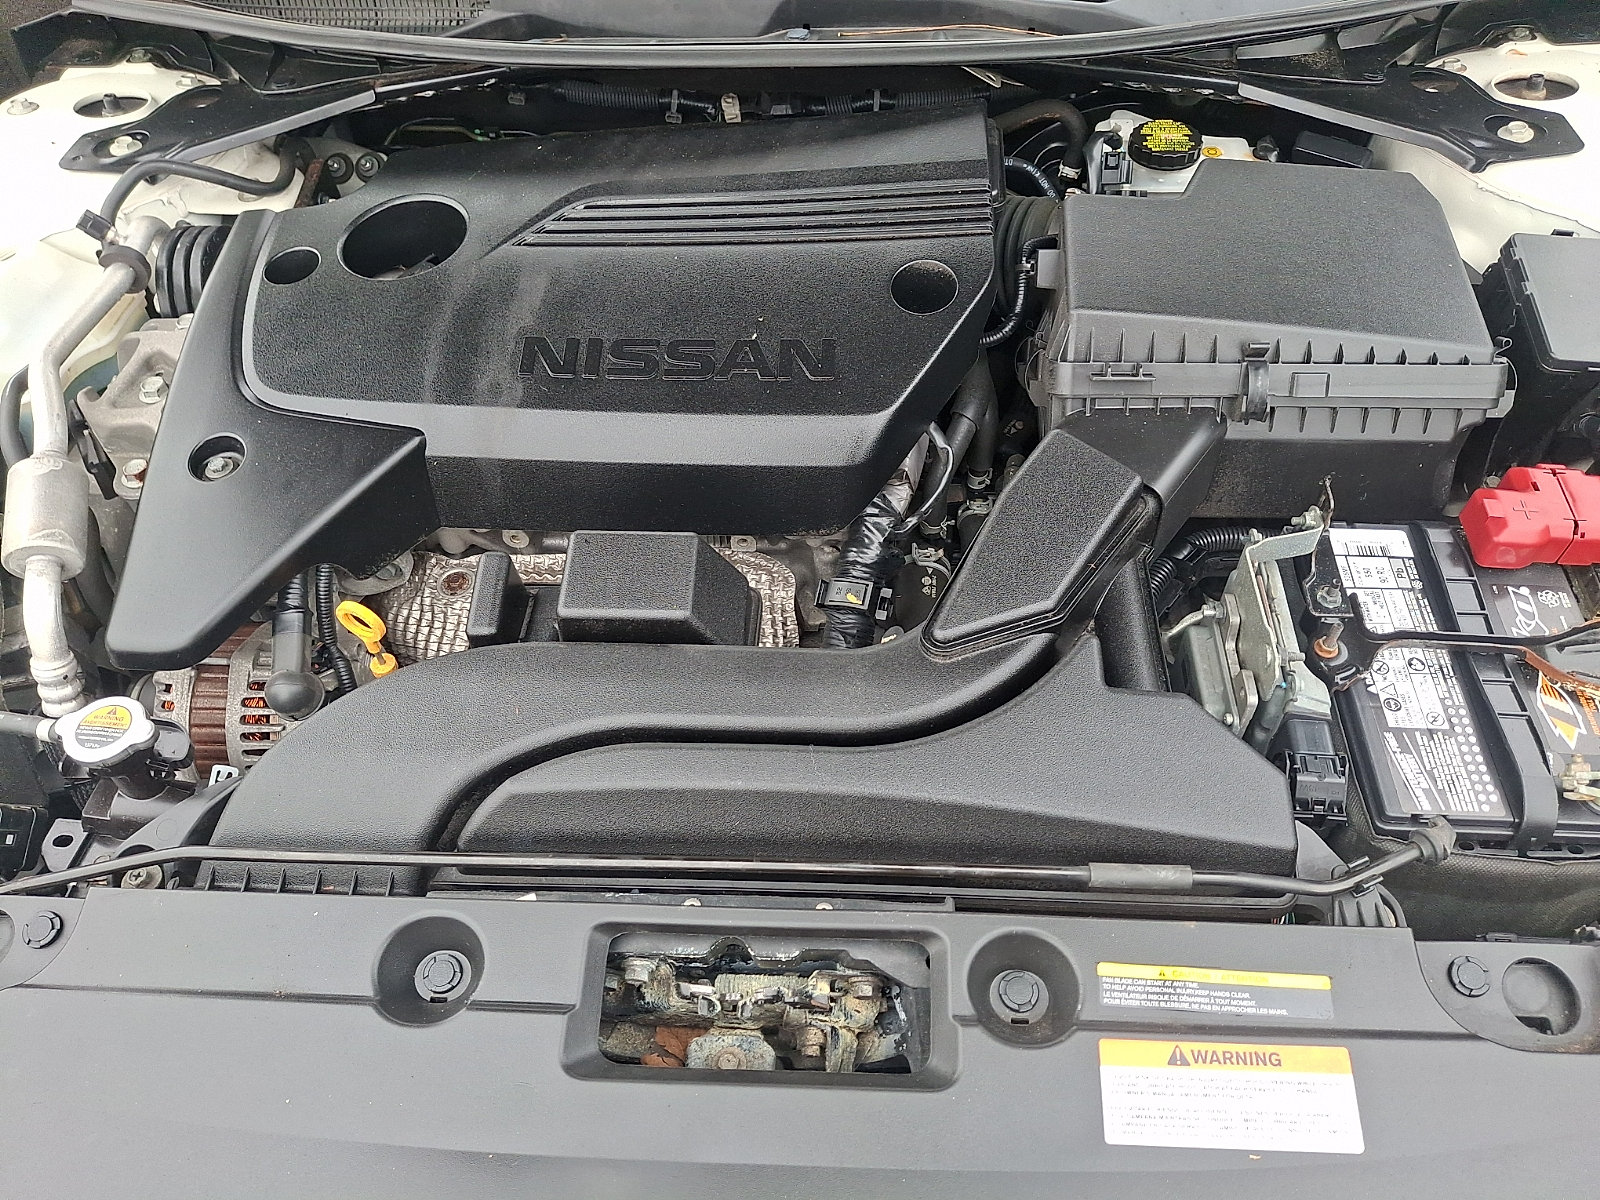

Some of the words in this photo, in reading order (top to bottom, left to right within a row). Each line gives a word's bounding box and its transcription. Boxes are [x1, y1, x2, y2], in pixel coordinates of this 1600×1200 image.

[517, 336, 836, 381] NISSAN
[1395, 567, 1406, 579] Pb
[1111, 991, 1147, 999] VENTILATEUR
[1191, 1049, 1282, 1067] WARNING
